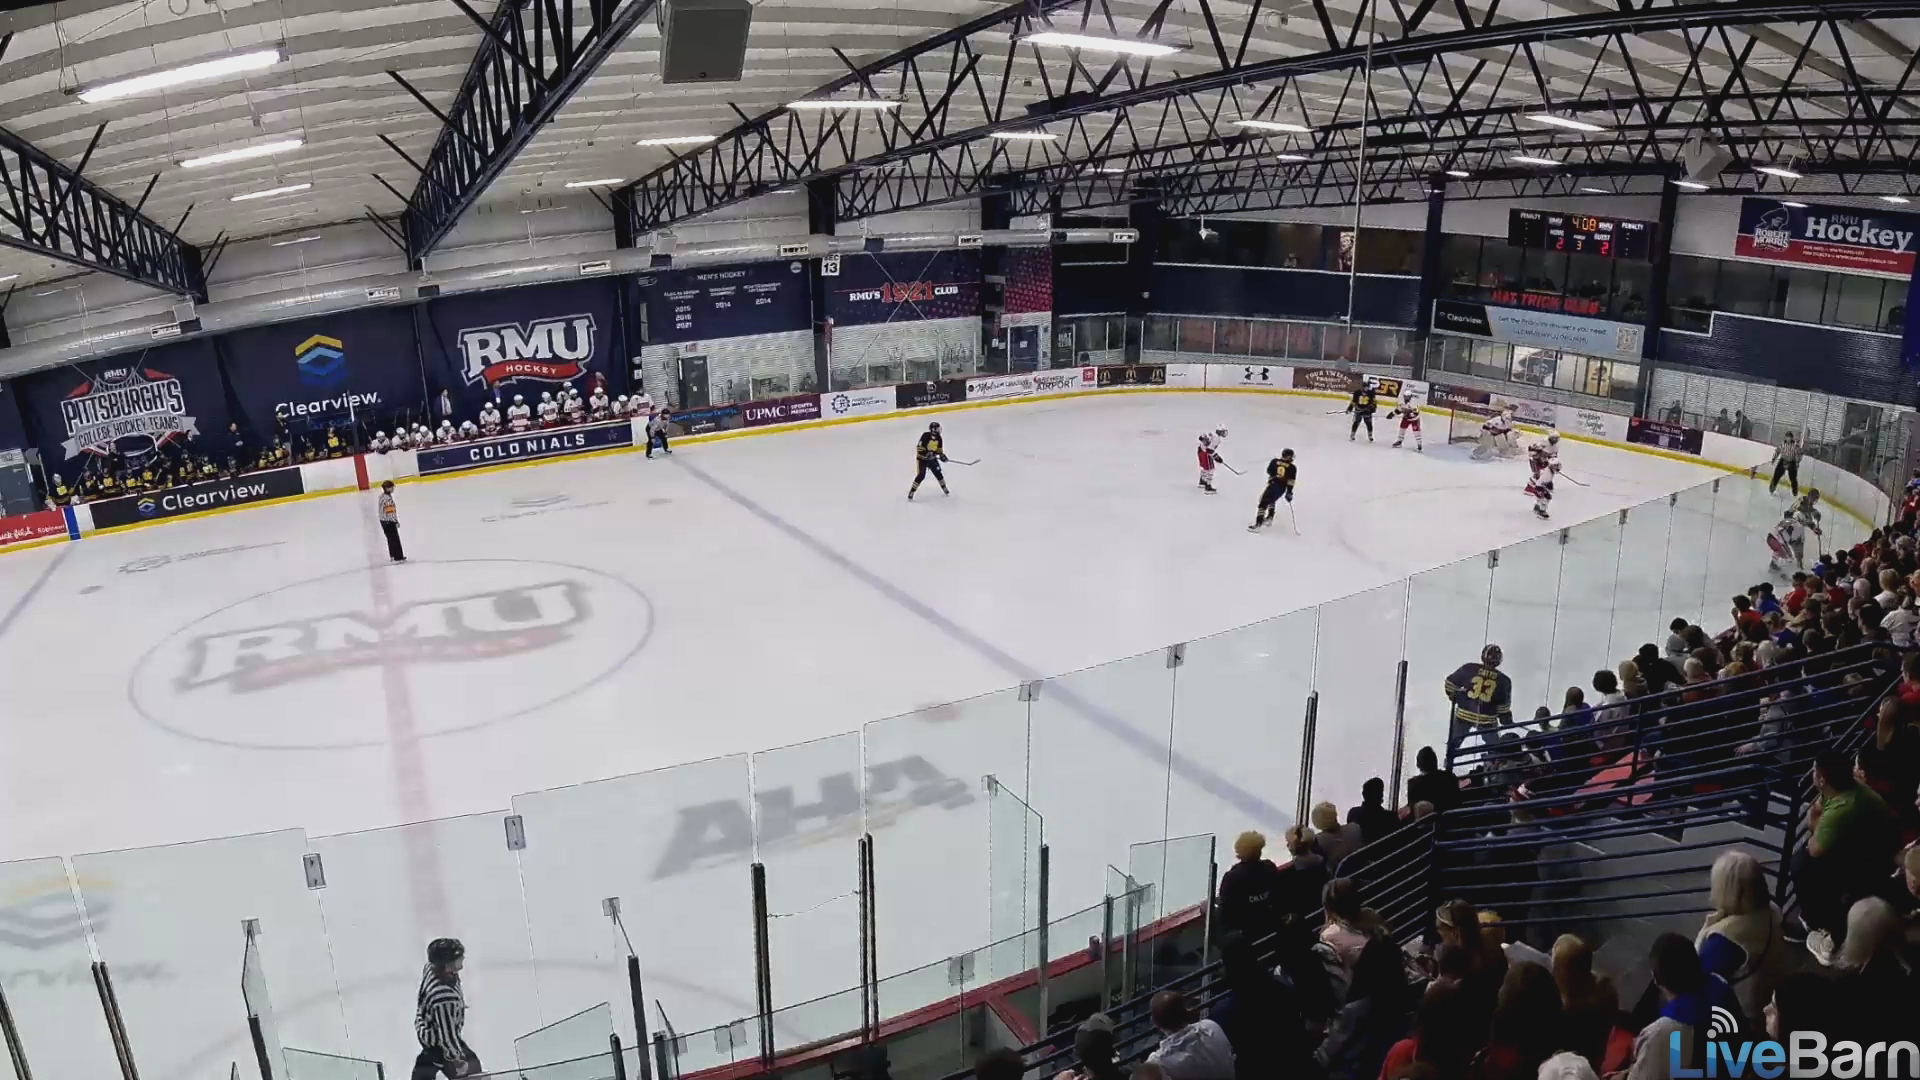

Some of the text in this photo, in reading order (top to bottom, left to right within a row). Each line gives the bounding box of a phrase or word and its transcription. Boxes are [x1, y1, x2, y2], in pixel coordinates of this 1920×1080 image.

[1572, 215, 1597, 231] 4:08
[1831, 213, 1859, 225] RMU
[1804, 216, 1914, 254] Hockey
[1576, 240, 1582, 250] 3
[1601, 241, 1609, 254] 2
[719, 270, 746, 279] HOCKEY
[823, 262, 838, 274] 13
[849, 280, 959, 304] RMU'S 1921 CLUB
[464, 318, 590, 379] RMU
[104, 368, 127, 380] RMU
[506, 364, 557, 375] HOCKEY
[1036, 376, 1078, 392] AIRPORT
[62, 380, 184, 435] PITTSBURGH'S
[745, 405, 786, 421] UPMC
[79, 416, 180, 448] COLLEGE HOCKEY TEAMS
[470, 433, 585, 461] COLONIALS
[182, 581, 588, 690] RMU
[1467, 676, 1497, 702] 33
